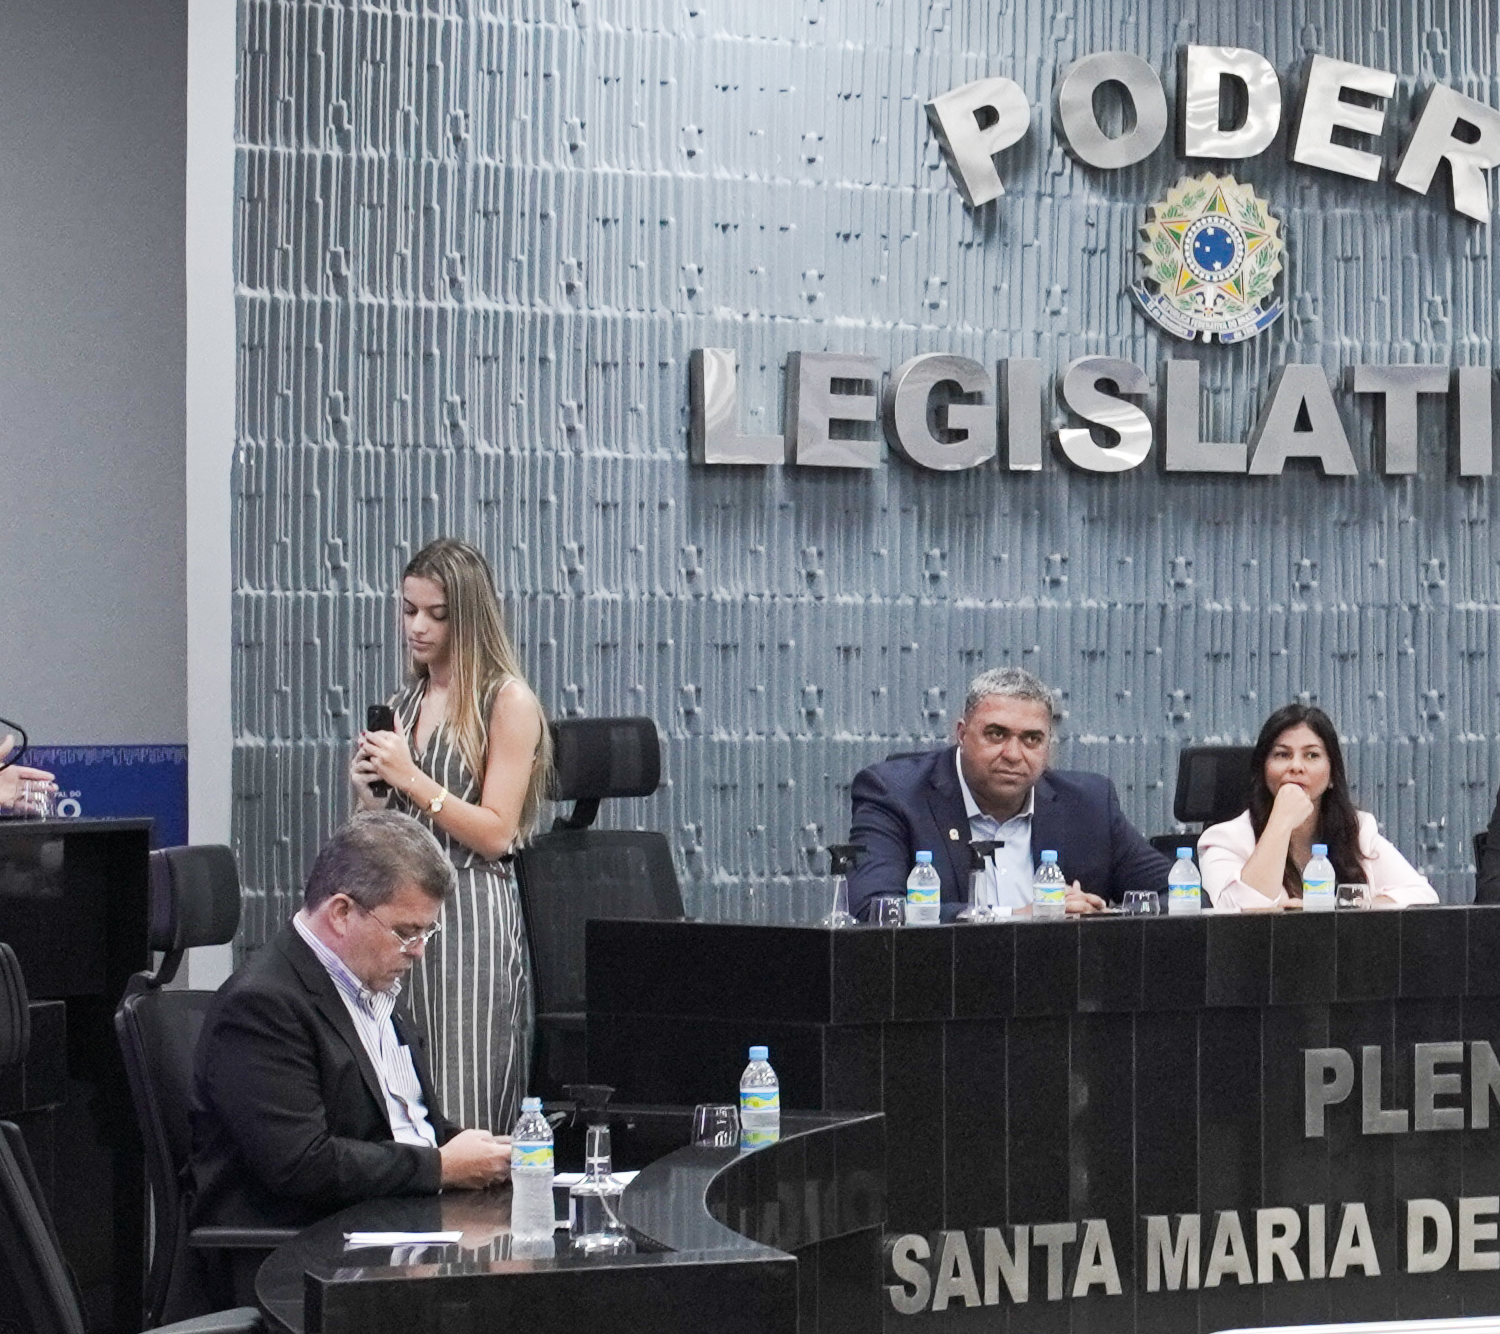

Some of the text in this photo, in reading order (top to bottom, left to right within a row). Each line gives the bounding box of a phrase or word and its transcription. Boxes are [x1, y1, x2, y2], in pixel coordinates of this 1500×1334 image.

[885, 1218, 1123, 1315] SANTA
[1141, 1201, 1382, 1293] MARIA
[1405, 1195, 1500, 1275] DE
